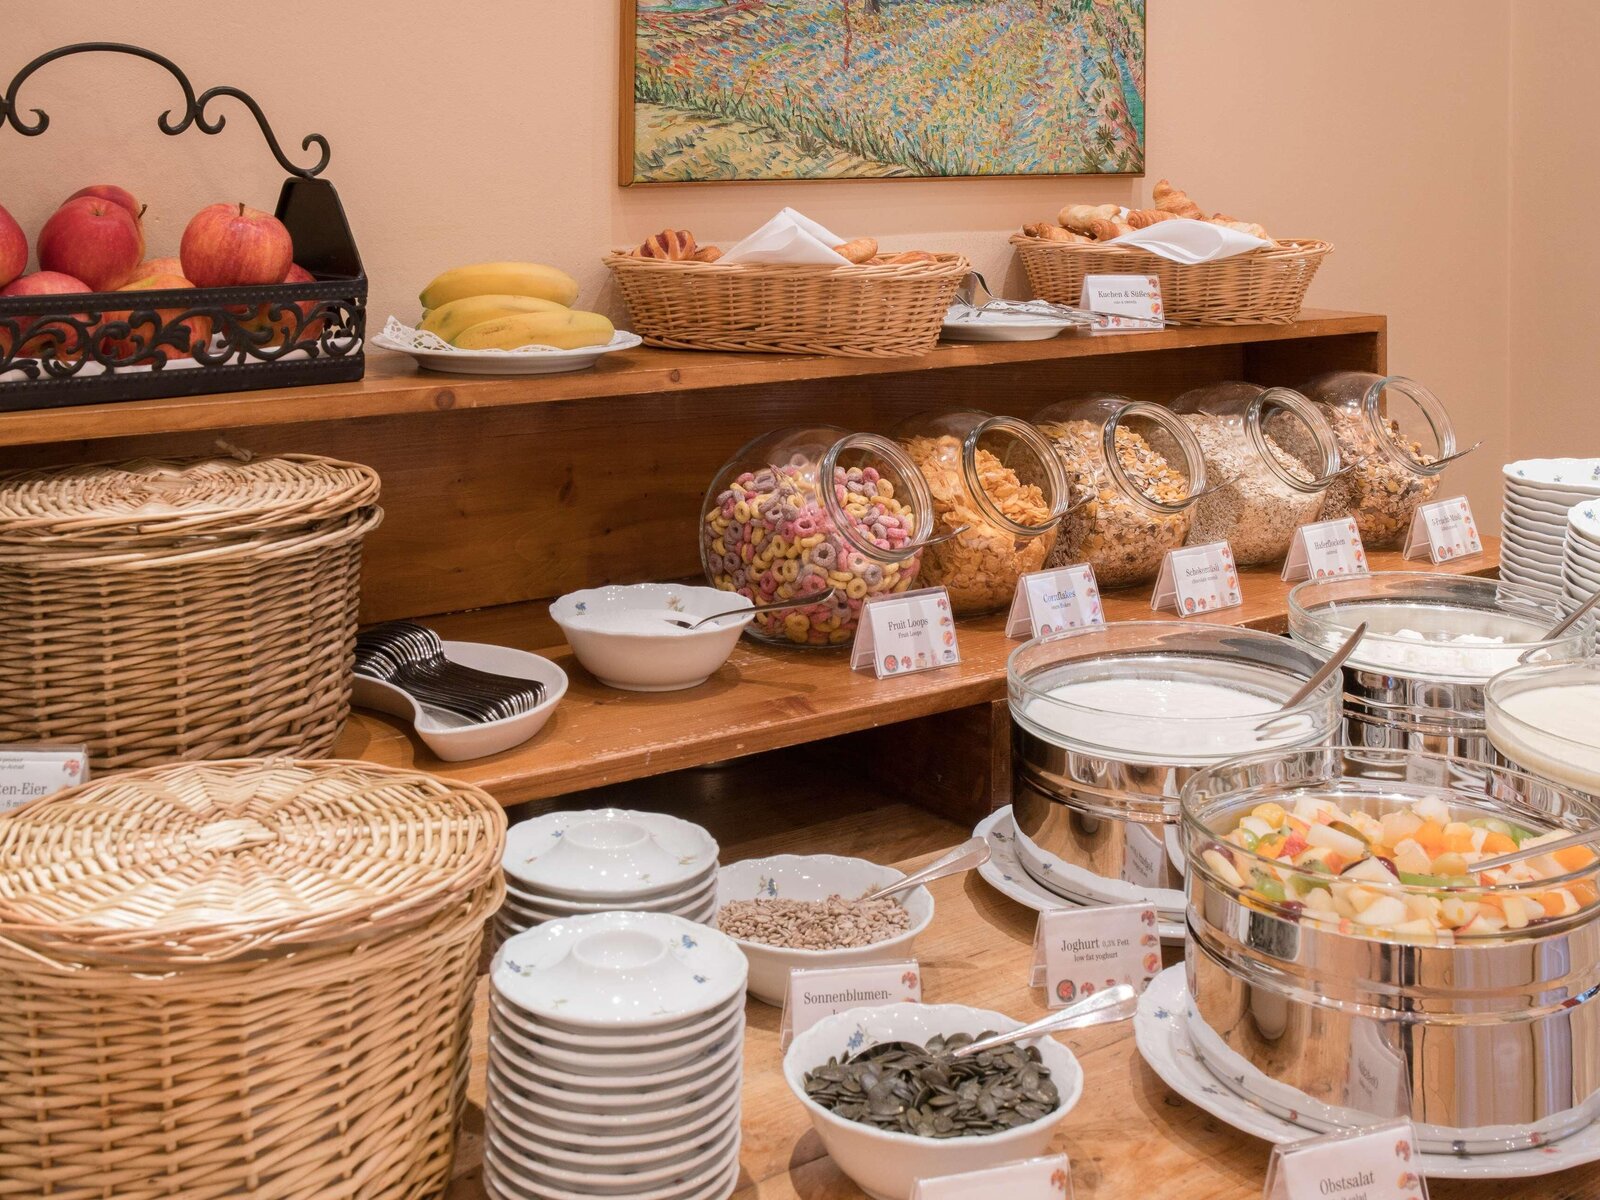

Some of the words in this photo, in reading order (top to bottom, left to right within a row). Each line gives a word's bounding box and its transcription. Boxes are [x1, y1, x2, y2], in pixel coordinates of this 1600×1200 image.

[1098, 290, 1123, 298] Kuchen
[1131, 290, 1151, 298] Süßes
[1043, 590, 1076, 603] Cornflakes
[888, 620, 906, 631] Fruit
[907, 618, 929, 628] Loops
[898, 631, 909, 639] Fruit
[909, 630, 922, 638] Loops
[0, 782, 47, 796] en-Eier
[1061, 938, 1100, 953] Joghurt
[1116, 939, 1129, 947] Fett
[1074, 954, 1084, 962] low
[1085, 953, 1094, 961] fat
[1095, 951, 1118, 961] yoghurt
[803, 988, 893, 1005] Sonnenblumen-
[1319, 1170, 1376, 1196] Obstsalat
